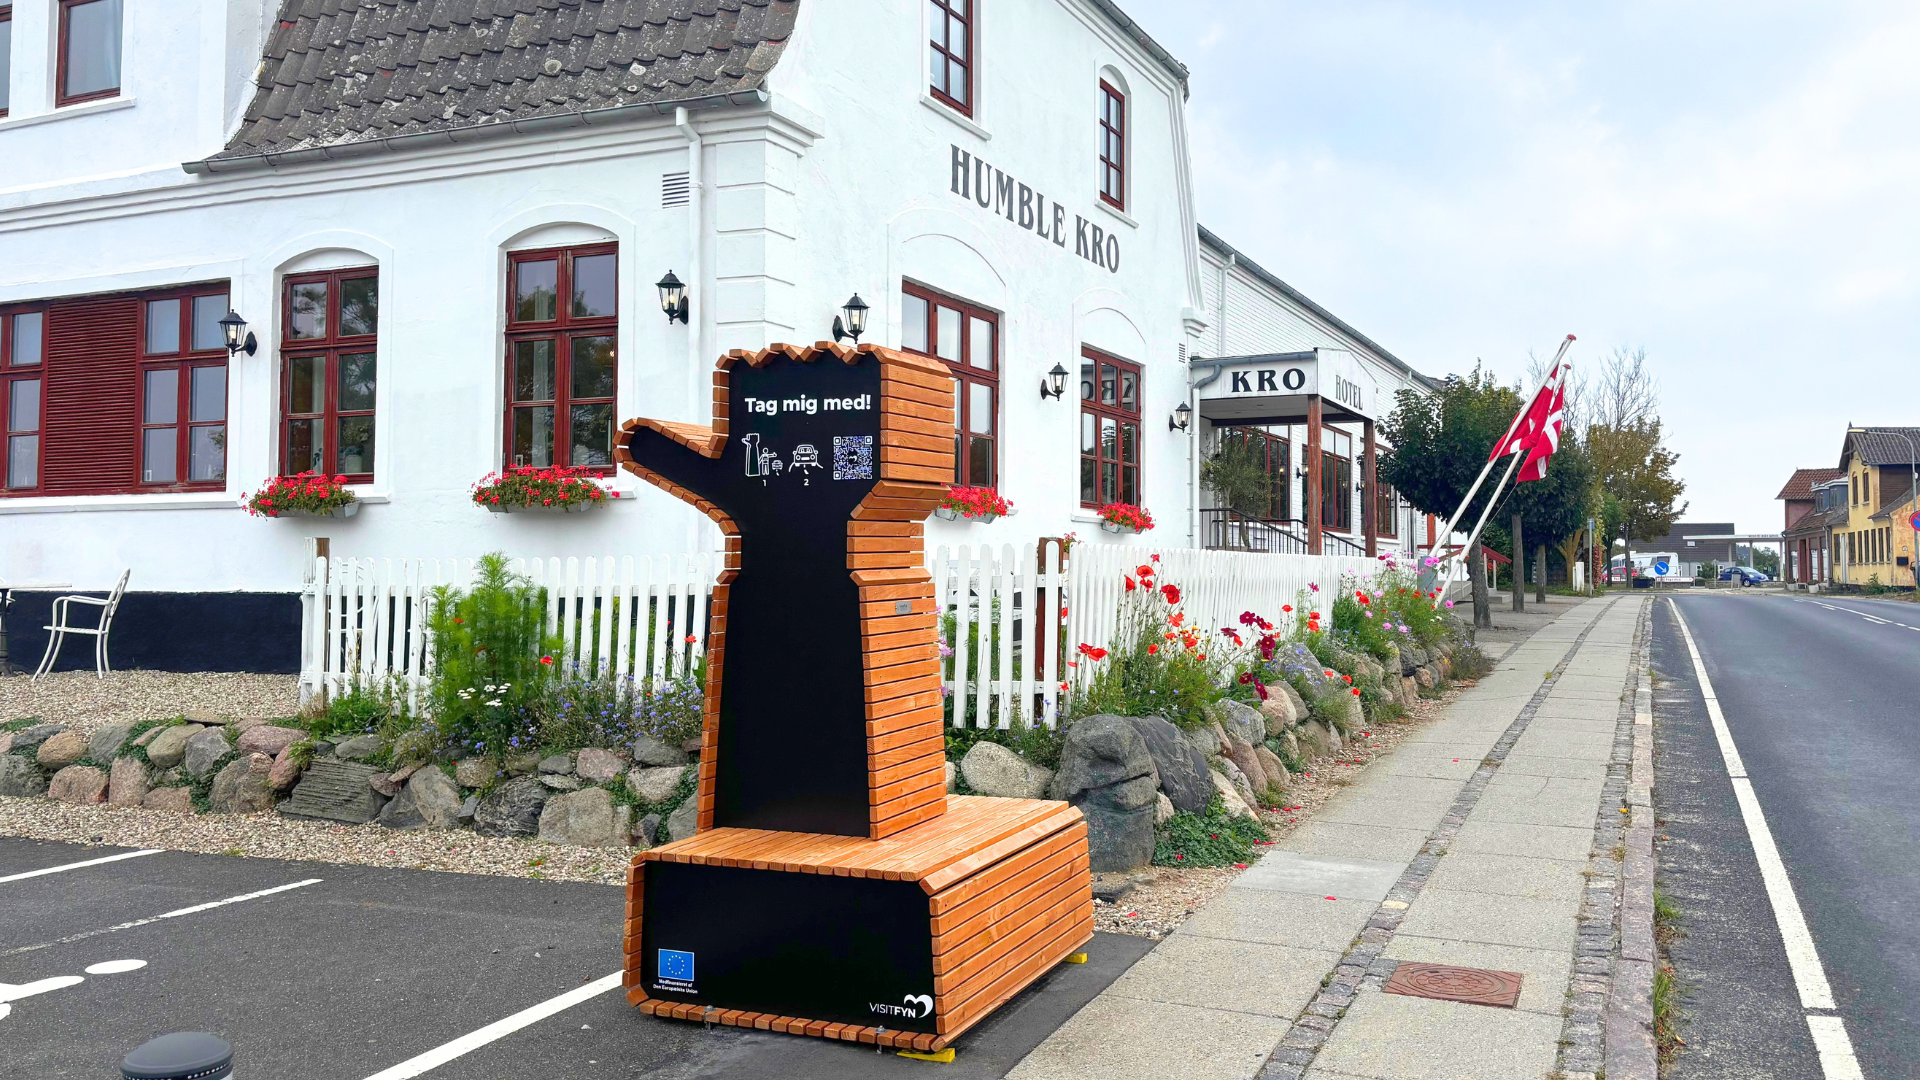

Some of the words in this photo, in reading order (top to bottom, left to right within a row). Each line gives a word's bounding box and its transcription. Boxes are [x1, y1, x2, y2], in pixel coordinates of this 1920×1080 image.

[950, 143, 1067, 248] HUMBLE
[1075, 214, 1120, 274] KRO
[1231, 368, 1306, 393] KRO
[1335, 374, 1363, 411] HOTEL
[744, 397, 778, 416] Tag
[782, 394, 818, 415] mig
[823, 393, 872, 411] med!
[762, 479, 767, 487] 1
[803, 478, 810, 486] 2
[869, 1002, 916, 1018] VISITFYN
